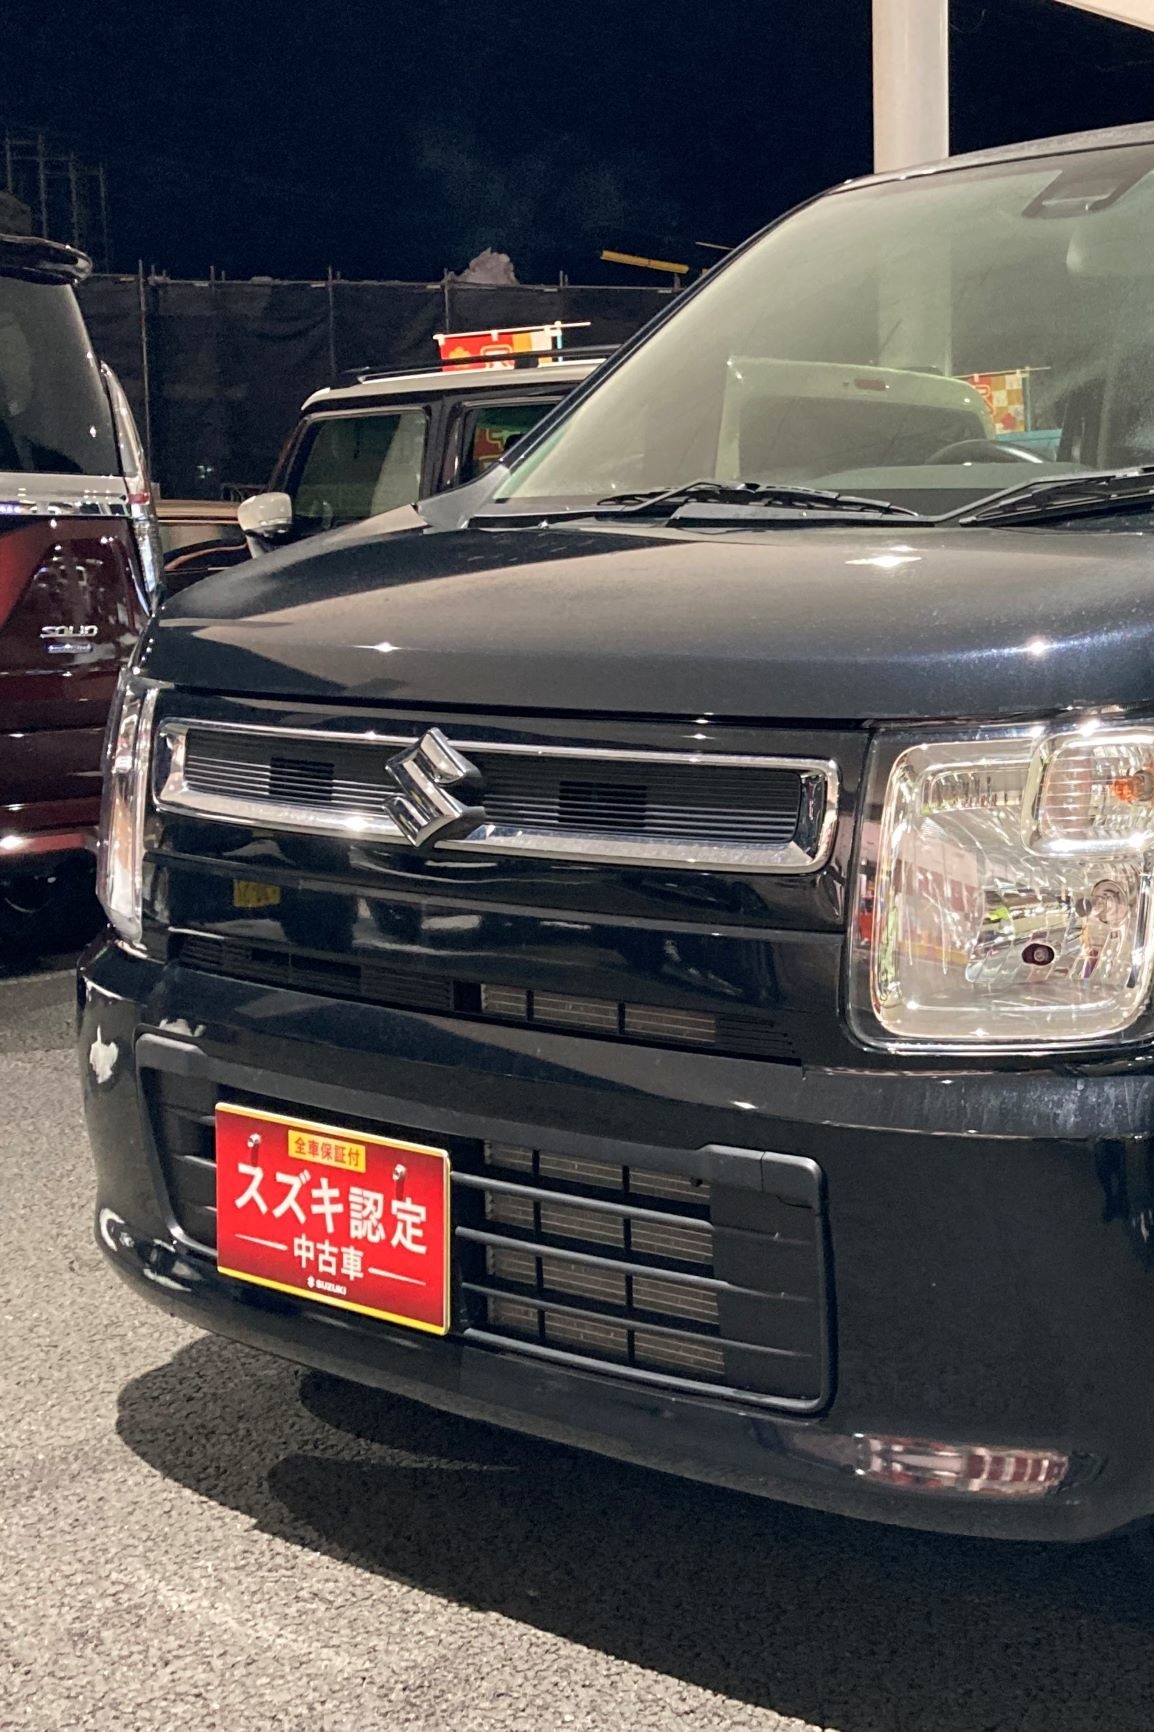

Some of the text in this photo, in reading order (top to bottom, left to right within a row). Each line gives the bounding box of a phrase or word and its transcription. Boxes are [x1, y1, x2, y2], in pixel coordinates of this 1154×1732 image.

[294, 1137, 361, 1167] 全車保証付
[234, 1162, 427, 1255] スズキ認定
[292, 1233, 364, 1281] 中古車
[315, 1280, 347, 1296] SUZUKI
